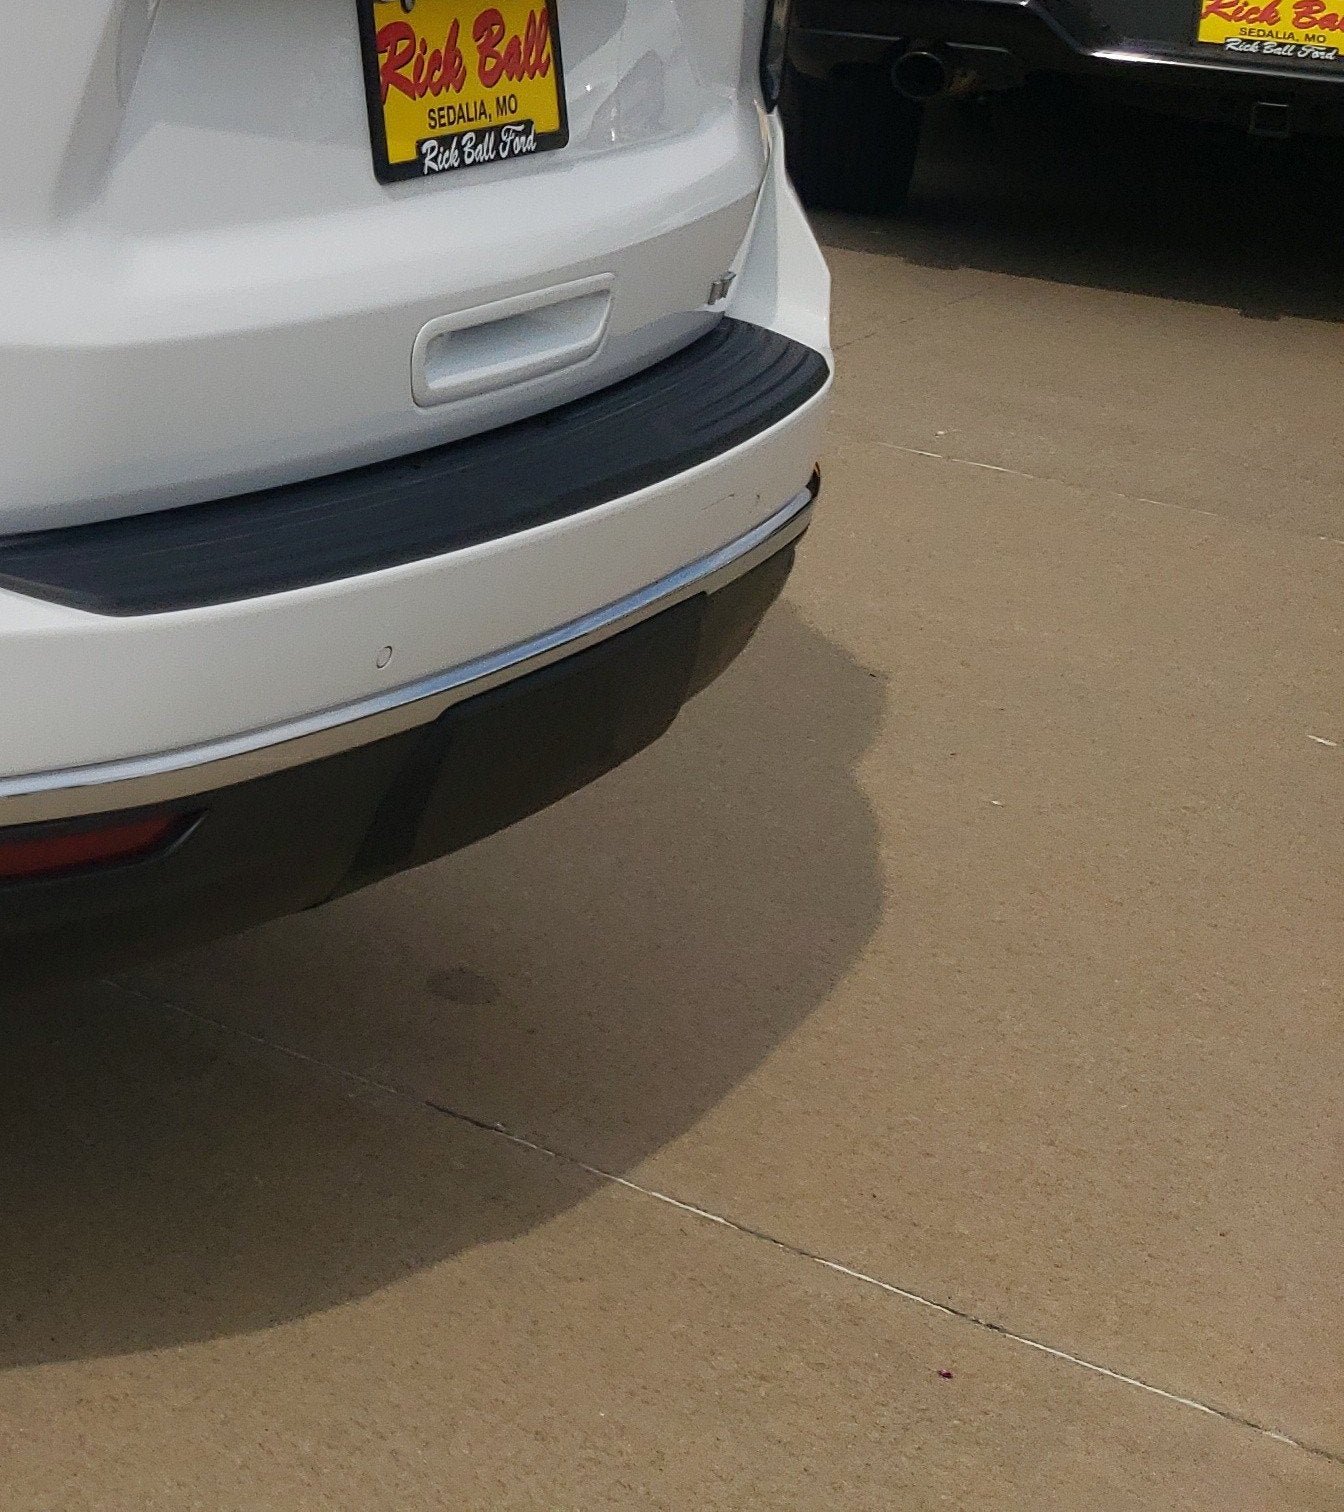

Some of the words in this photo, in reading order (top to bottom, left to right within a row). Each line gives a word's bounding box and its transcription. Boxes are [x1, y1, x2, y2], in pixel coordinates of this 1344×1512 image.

[1225, 38, 1262, 53] Rick
[1262, 41, 1296, 57] Ball
[1297, 44, 1337, 60] Ford
[1239, 27, 1299, 42] SEDALIA,
[1304, 32, 1327, 44] MO
[376, 18, 467, 105] Rick
[472, 7, 551, 88] Ball
[427, 100, 493, 129] SEDALIA,
[496, 93, 518, 116] MO
[421, 139, 461, 174] Rick
[461, 132, 496, 164] Ball
[498, 125, 536, 158] Ford
